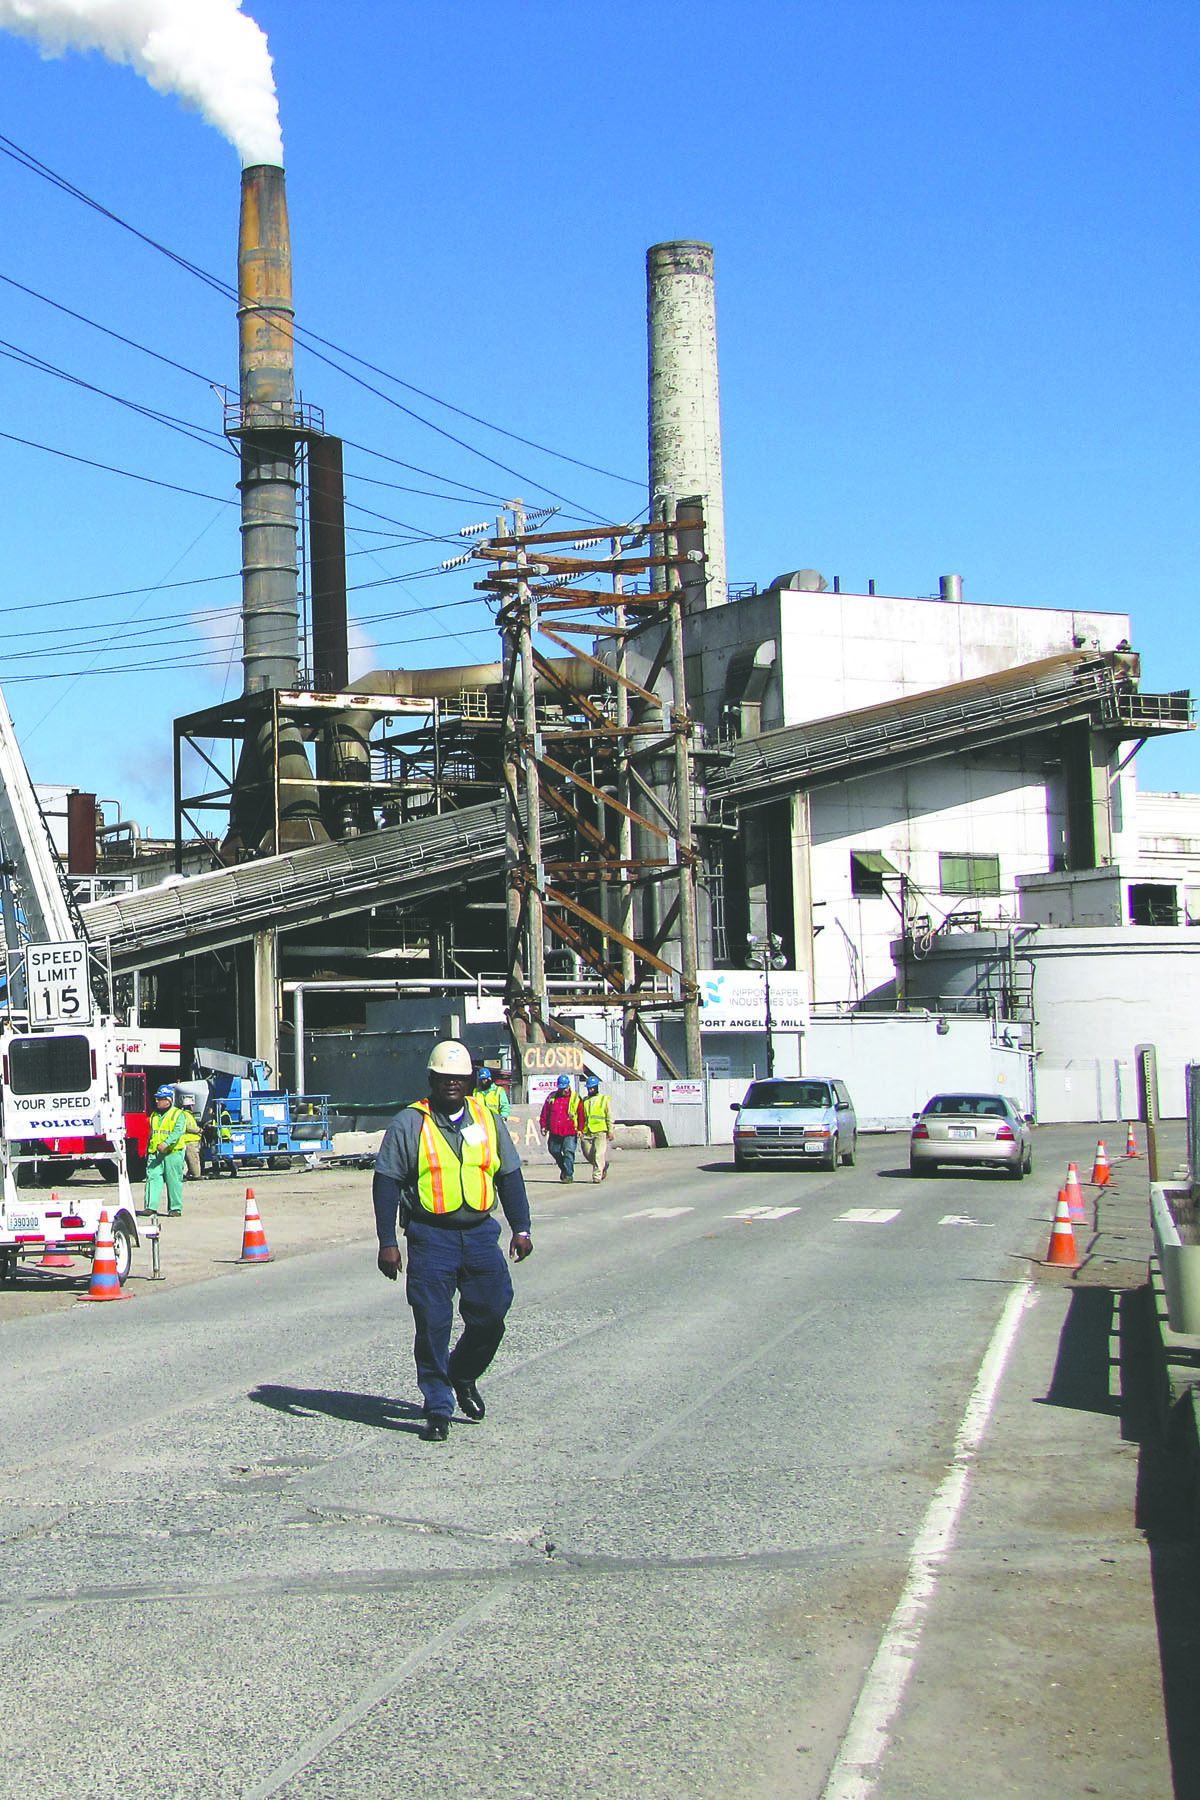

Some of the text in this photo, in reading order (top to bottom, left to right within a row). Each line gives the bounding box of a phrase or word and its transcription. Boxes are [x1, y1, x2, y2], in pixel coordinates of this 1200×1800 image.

[32, 950, 83, 966] SPEED
[38, 968, 77, 982] LIMIT
[732, 988, 799, 997] NIPPON PAPER
[42, 988, 80, 1015] 15
[729, 998, 805, 1006] INDUSTIES USA
[524, 1046, 584, 1069] CLOSED
[14, 1097, 91, 1110] YOUR SPEED
[29, 1118, 94, 1129] POLICE
